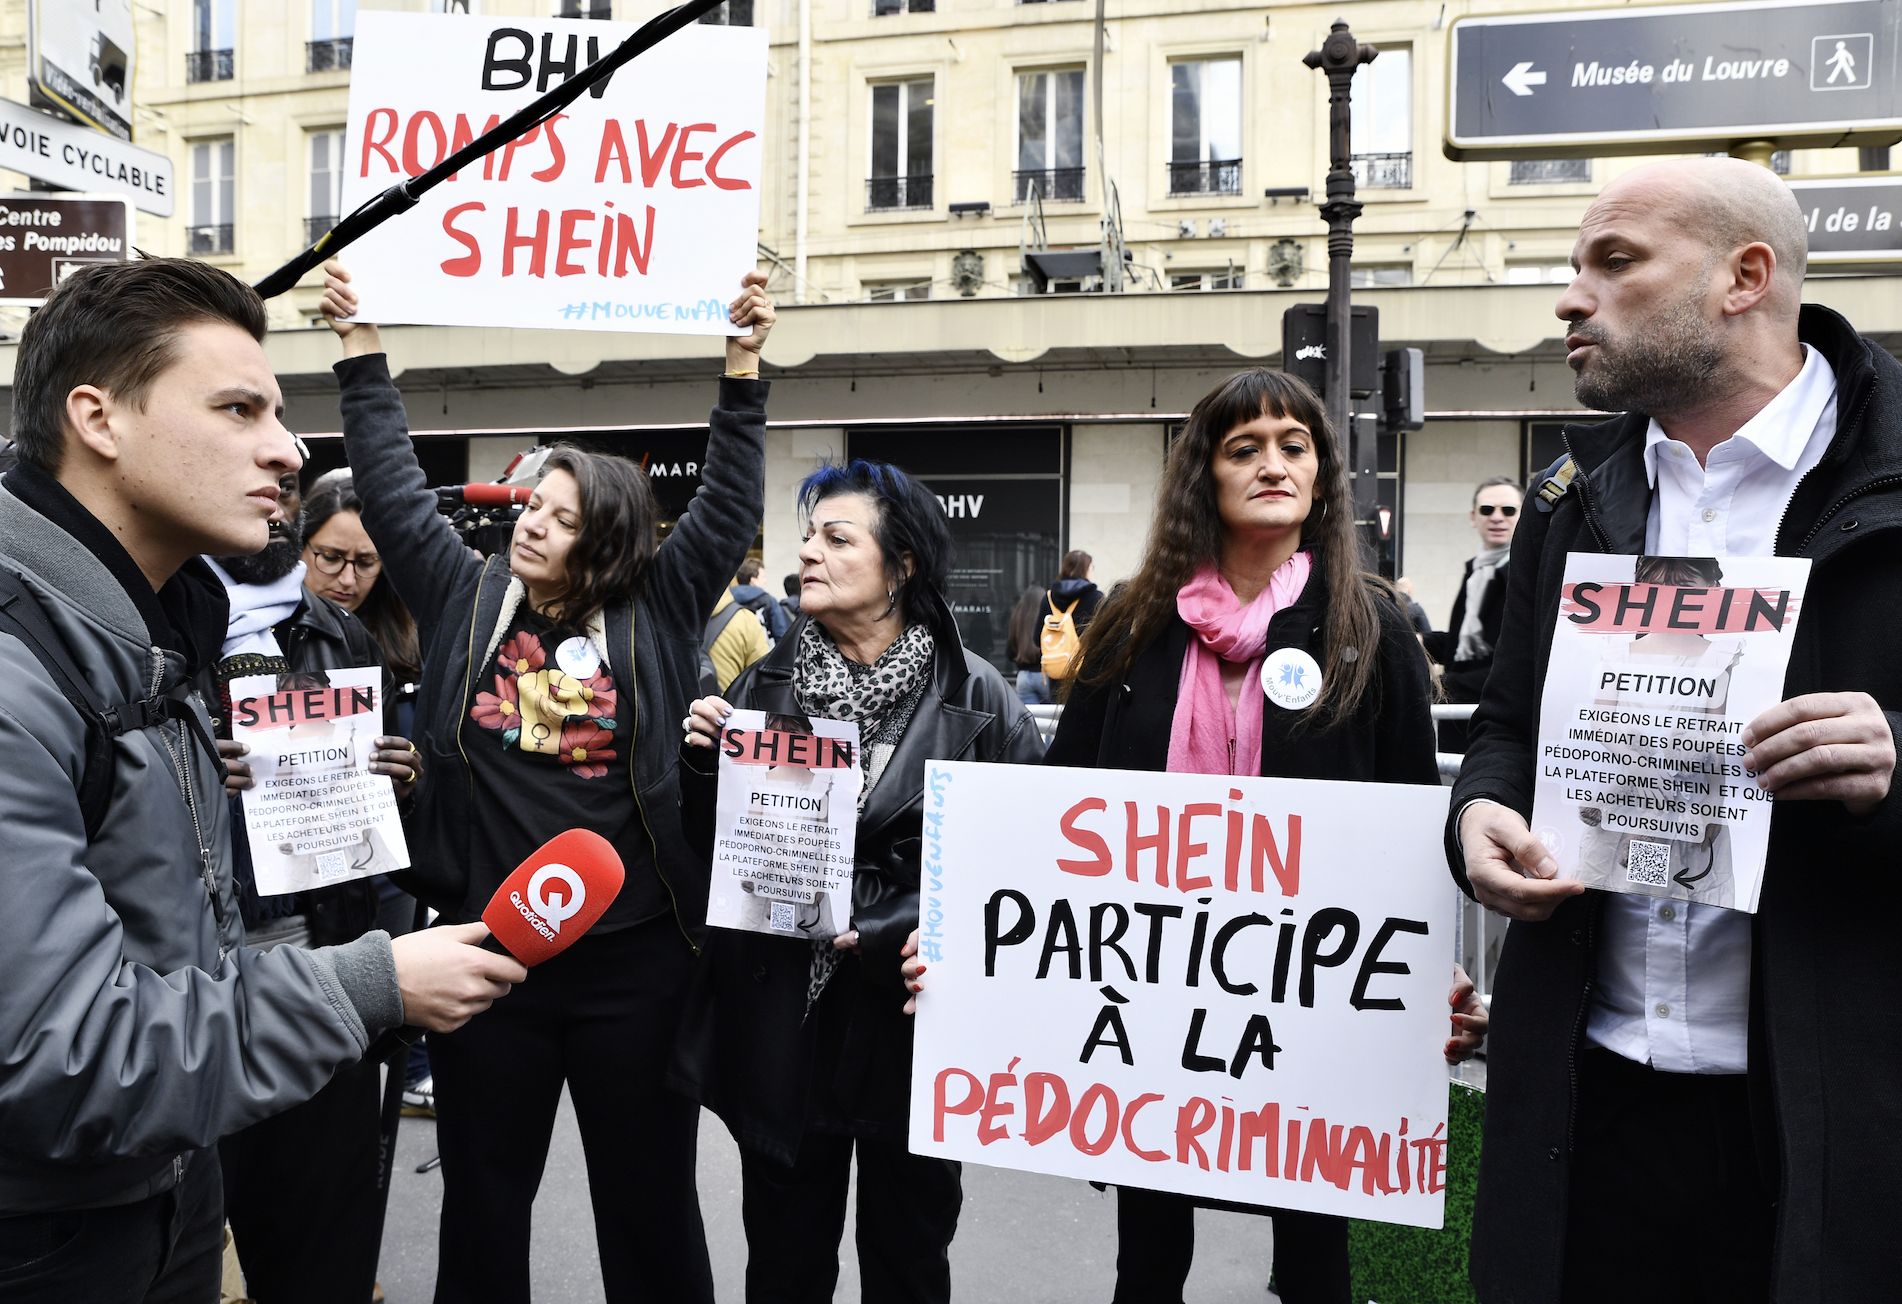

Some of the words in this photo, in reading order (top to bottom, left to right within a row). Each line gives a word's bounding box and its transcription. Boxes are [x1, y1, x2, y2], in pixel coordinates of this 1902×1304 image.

[481, 27, 625, 99] BHV
[1571, 59, 1652, 88] Musée
[1661, 59, 1692, 84] du
[1702, 56, 1788, 82] Louvre
[0, 123, 51, 157] VOIE
[63, 144, 166, 196] CYCLABLE
[359, 108, 569, 183] ROMPS
[594, 118, 756, 190] AVEC
[0, 205, 62, 227] Centre
[1825, 206, 1859, 232] de
[1866, 205, 1892, 231] la
[23, 231, 122, 256] Pompidou
[649, 461, 698, 477] MAR
[1567, 582, 1790, 633] SHEIN
[1601, 672, 1716, 697] PETITION
[238, 686, 373, 727] SHEIN
[1579, 709, 1650, 726] EXIGEONS
[1655, 716, 1672, 728] LE
[1677, 718, 1743, 734] RETRAIT
[725, 729, 851, 769] SHEIN
[1569, 728, 1635, 745] IMMÉDIAT
[1640, 736, 1668, 748] DES
[1673, 738, 1746, 756] POUPÉES
[279, 747, 348, 767] PETITION
[1545, 744, 1741, 777] PÉDOPORNO-CRIMINELLES
[266, 777, 316, 788] EXIGEONS
[318, 775, 329, 784] LE
[331, 770, 370, 782] RETRAIT
[310, 787, 327, 798] DES
[330, 780, 376, 795] POUPÉES
[1545, 766, 1561, 778] LA
[1566, 768, 1658, 789] PLATEFORME
[1663, 779, 1710, 795] SHEIN
[1720, 785, 1737, 798] ET
[751, 792, 821, 811] PETITION
[1567, 788, 1591, 801] LES
[1596, 792, 1686, 813] ACHETEURS
[1691, 803, 1748, 821] SOIENT
[251, 820, 261, 830] LA
[264, 813, 326, 828] PLATEFORME
[329, 808, 359, 820] SHEIN
[364, 804, 375, 813] ET
[267, 832, 284, 841] LES
[287, 823, 346, 839] ACHETEURS
[349, 815, 385, 828] SOIENT
[740, 817, 784, 830] EXIGEONS
[787, 822, 797, 831] LE
[801, 823, 838, 835] RETRAIT
[1607, 814, 1699, 836] POURSUIVIS
[297, 833, 359, 850] POURSUIVIS
[778, 834, 795, 844] DES
[799, 837, 841, 850] POUPÉES
[719, 853, 730, 861] LA
[733, 854, 788, 870] PLATEFORME
[790, 864, 818, 874] SHEIN
[824, 867, 834, 876] ET
[733, 868, 749, 877] LES
[751, 871, 803, 885] ACHETEURS
[806, 879, 840, 889] SOIENT
[758, 885, 811, 900] POURSUIVIS
[1079, 985, 1134, 1065] À
[1182, 1008, 1282, 1079] LA
